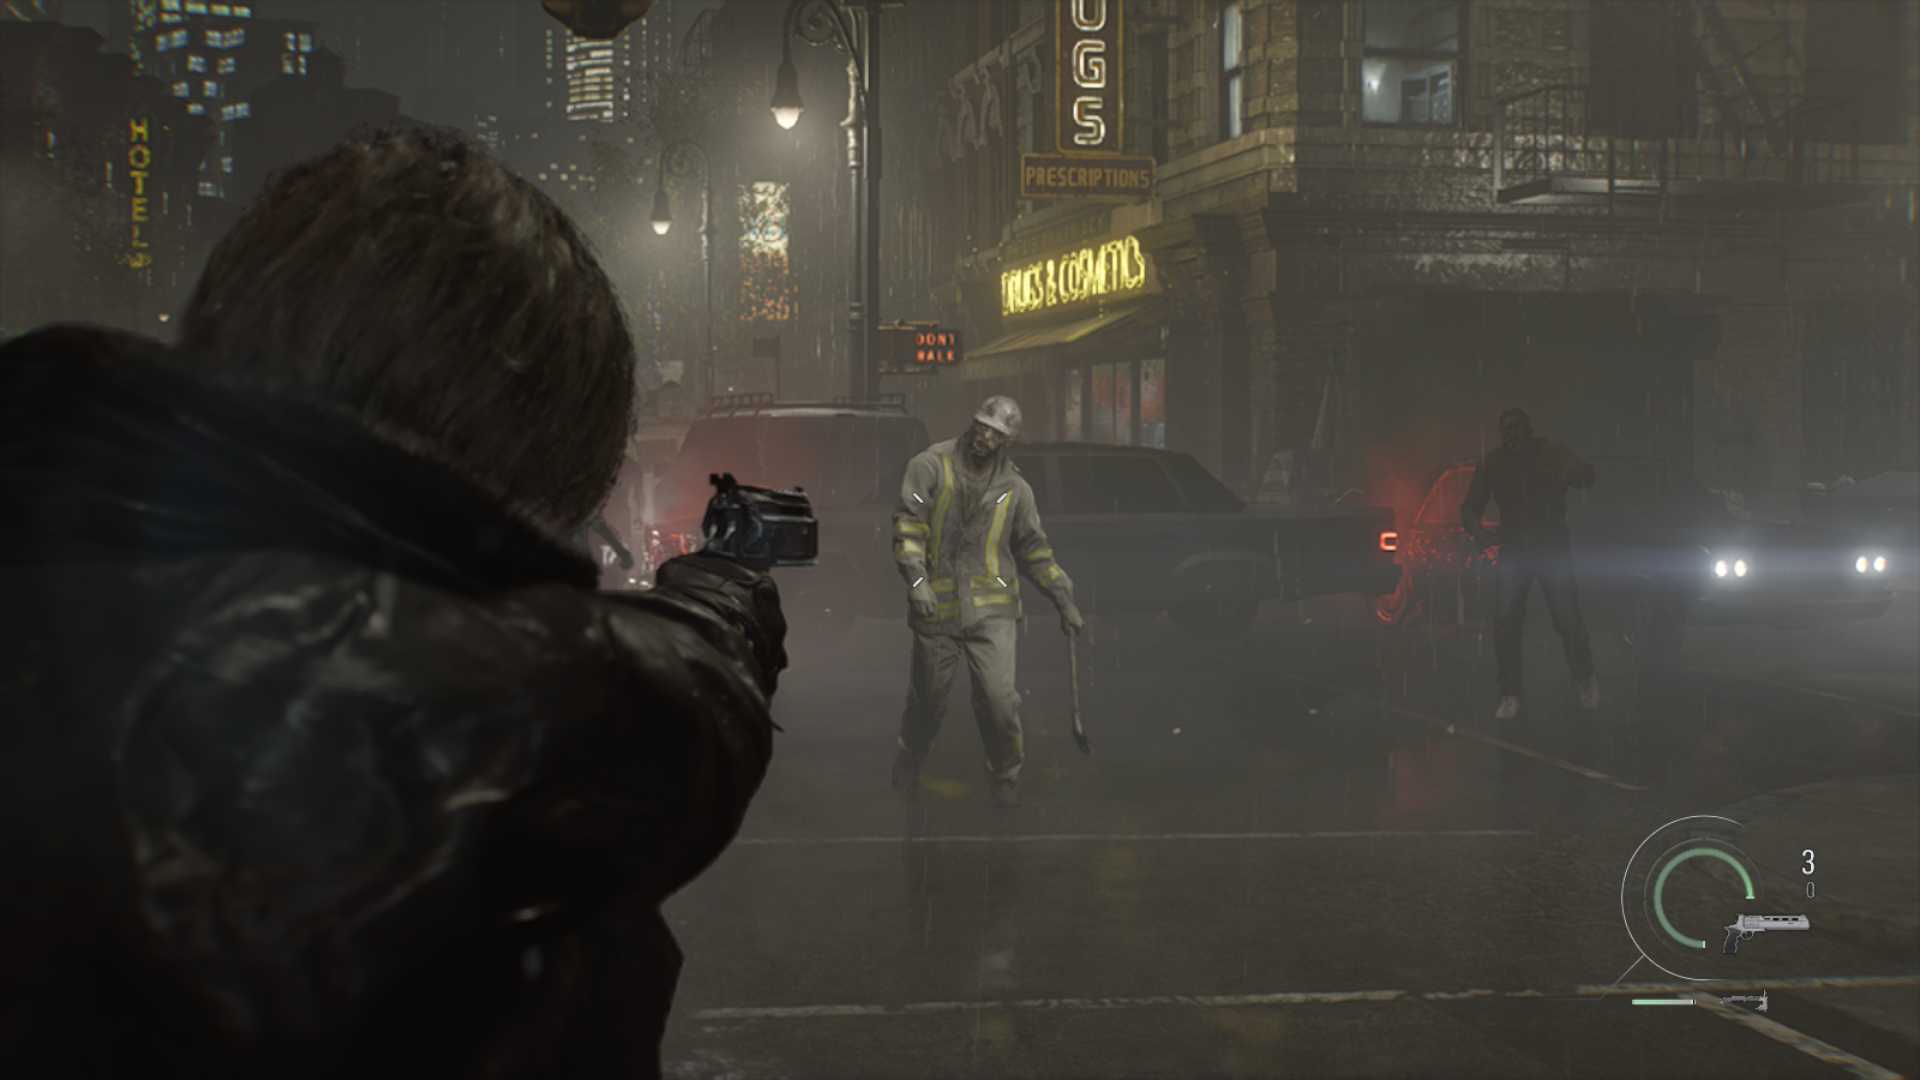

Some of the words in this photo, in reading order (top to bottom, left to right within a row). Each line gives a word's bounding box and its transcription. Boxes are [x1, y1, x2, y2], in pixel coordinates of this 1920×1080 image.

[1024, 166, 1152, 190] PRESCRIPTIONS
[1045, 259, 1057, 307] &
[1058, 235, 1146, 304] COSMETICS
